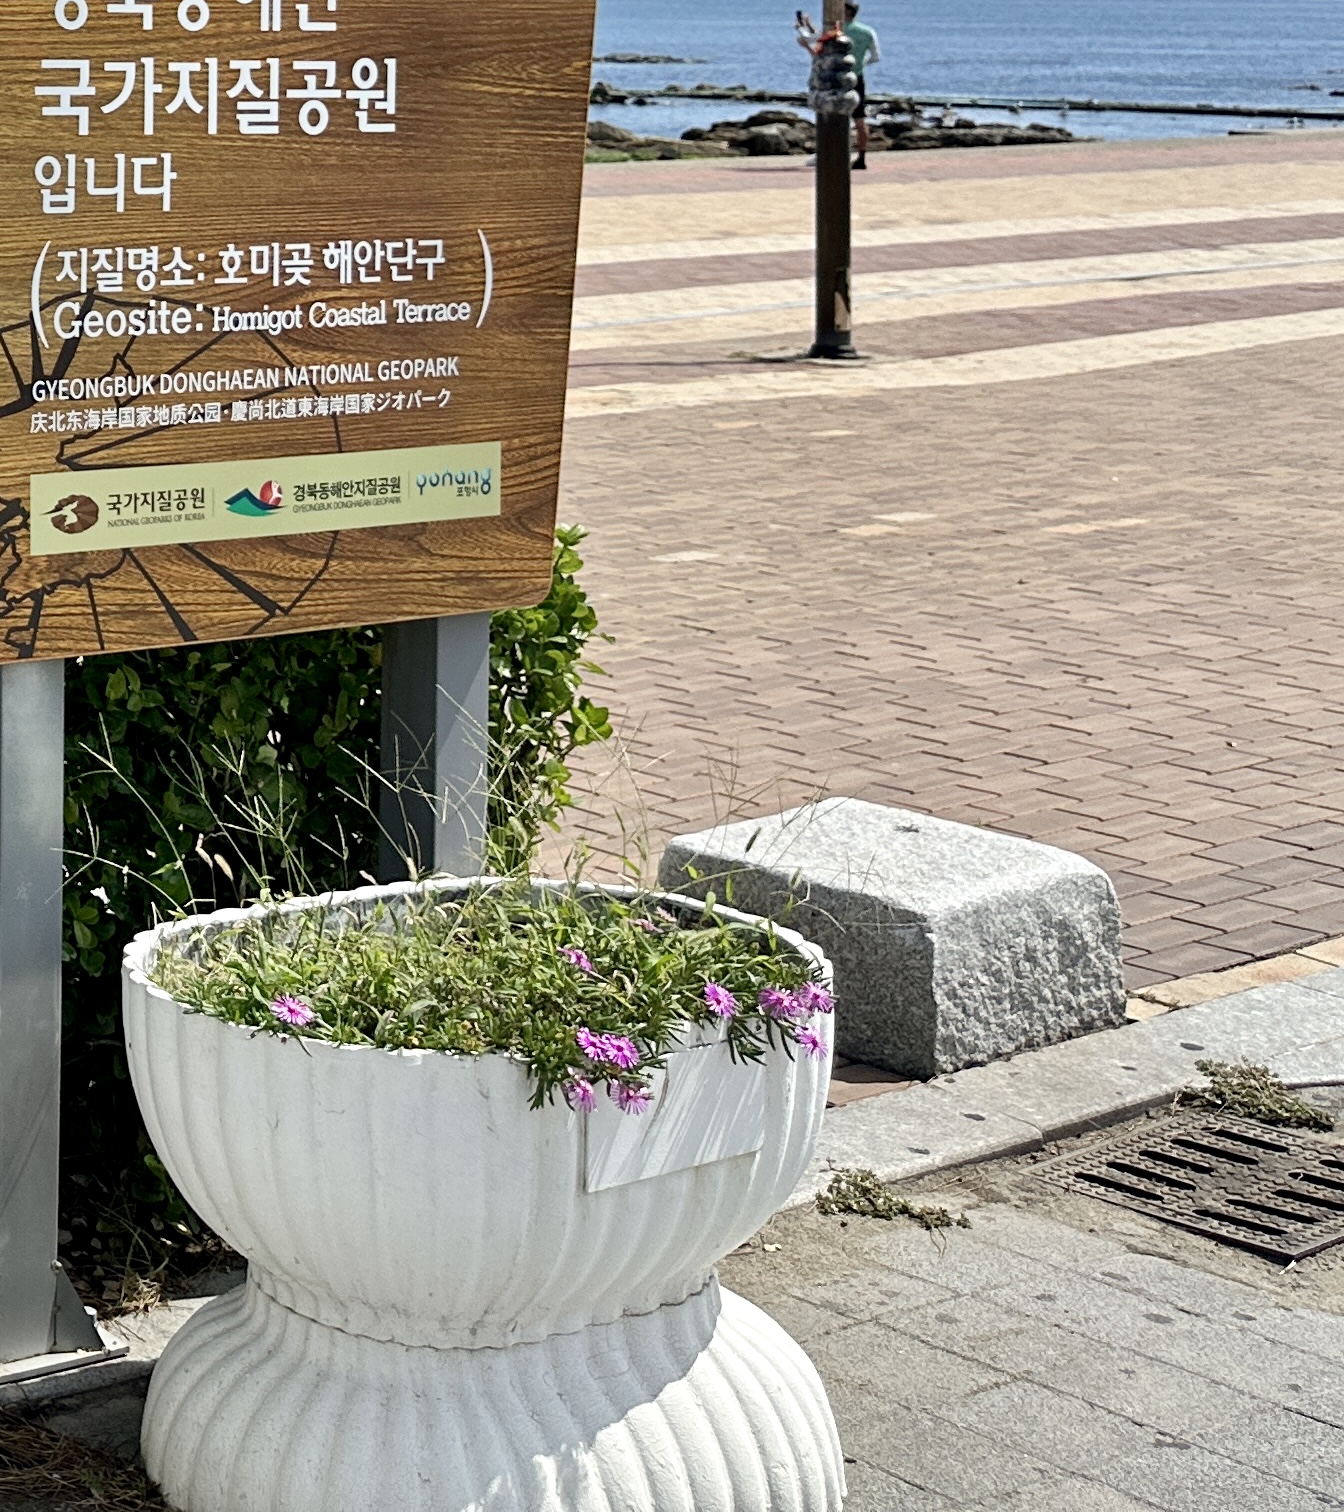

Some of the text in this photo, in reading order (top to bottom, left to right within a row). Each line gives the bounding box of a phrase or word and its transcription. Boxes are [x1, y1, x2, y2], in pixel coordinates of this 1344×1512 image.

[34, 56, 397, 136] 국가지질공원
[34, 152, 177, 215] 입니다
[214, 242, 313, 287] 호미곶
[322, 238, 446, 284] 해안단구
[212, 306, 303, 336] Homigot
[308, 299, 387, 329] Coastal
[392, 298, 471, 324] Terrace
[32, 355, 459, 403] GYEONGBUK DONGHAEAN NATIONAL GEOPARK
[106, 487, 205, 516] 국가지질공원
[293, 476, 401, 502] 경북동해안지질공원
